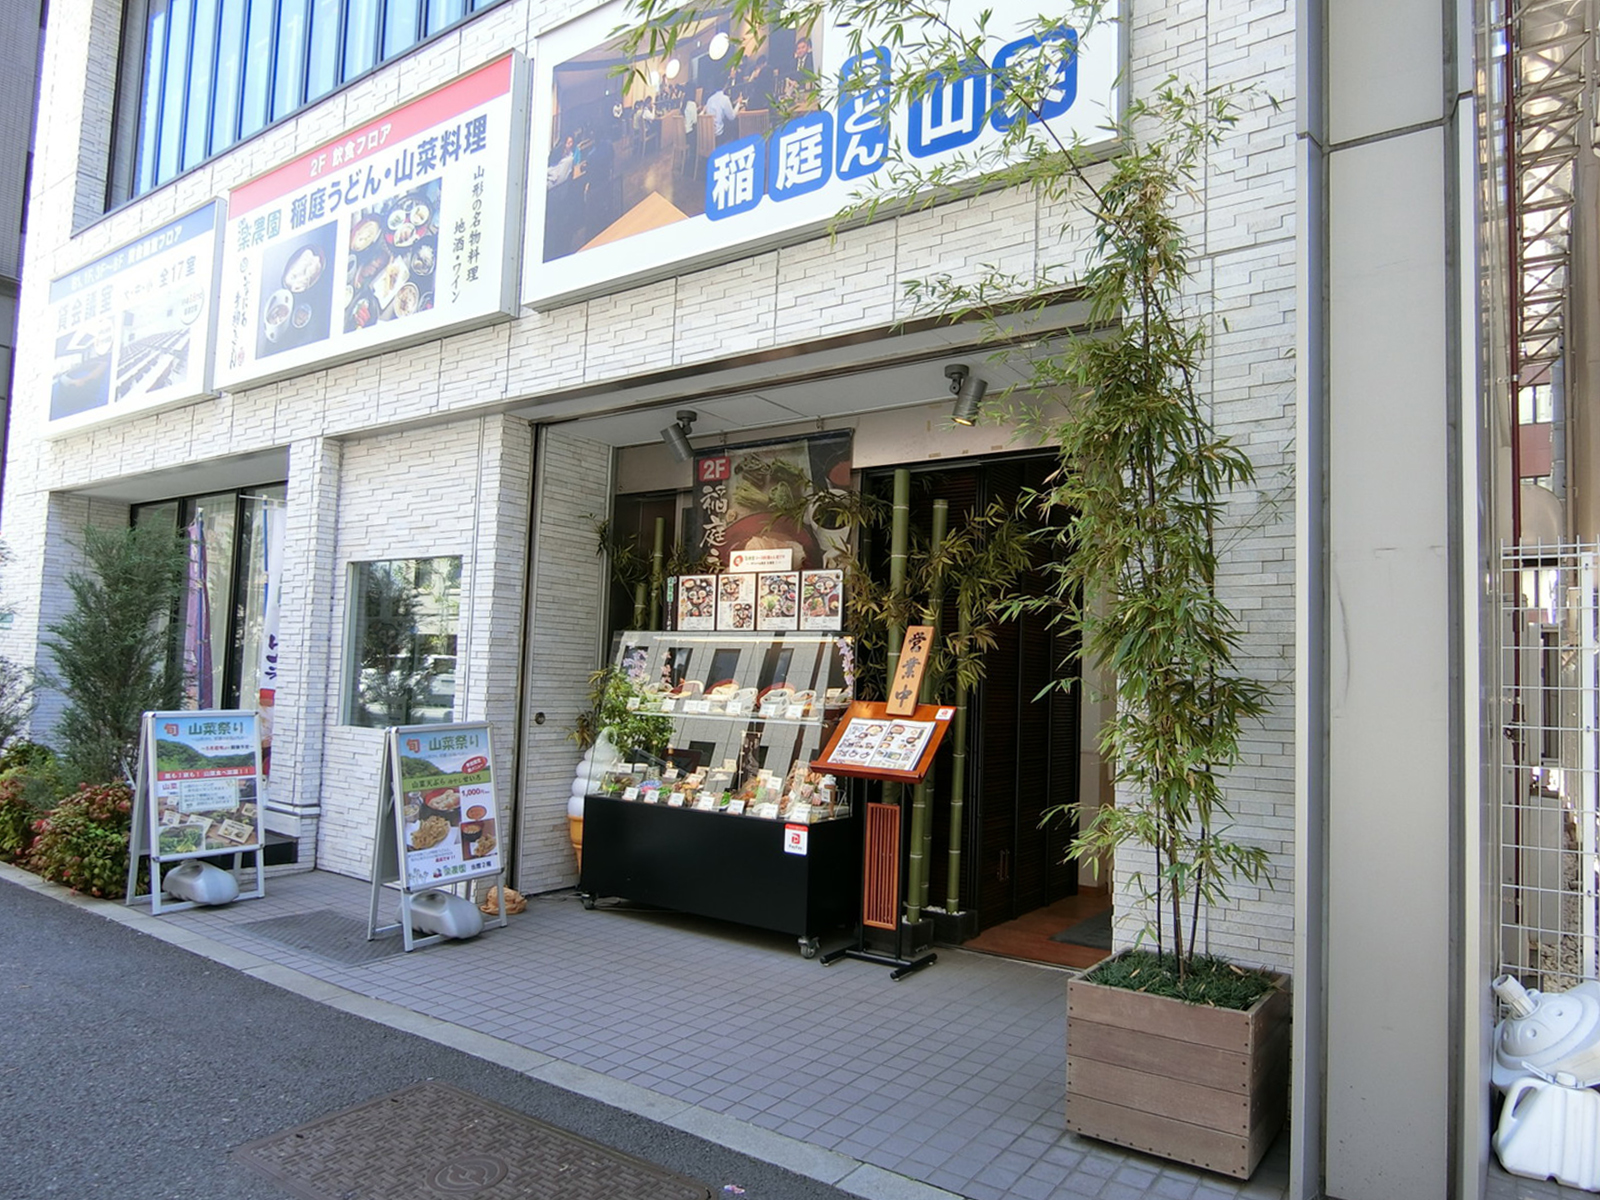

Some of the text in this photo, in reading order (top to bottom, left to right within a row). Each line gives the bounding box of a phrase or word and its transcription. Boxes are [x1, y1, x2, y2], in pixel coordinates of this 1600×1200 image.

[290, 114, 488, 230] 稲庭うどん・山菜料理
[309, 123, 392, 177] 2F 飲食フロア
[466, 165, 485, 283] 山形の名物料理
[451, 218, 466, 304] 地酒・ワイン
[702, 458, 726, 480] 2F
[895, 631, 926, 708] 営業中
[164, 721, 244, 737] 旬 山菜祭り
[406, 734, 479, 753] 旬 山菜祭り
